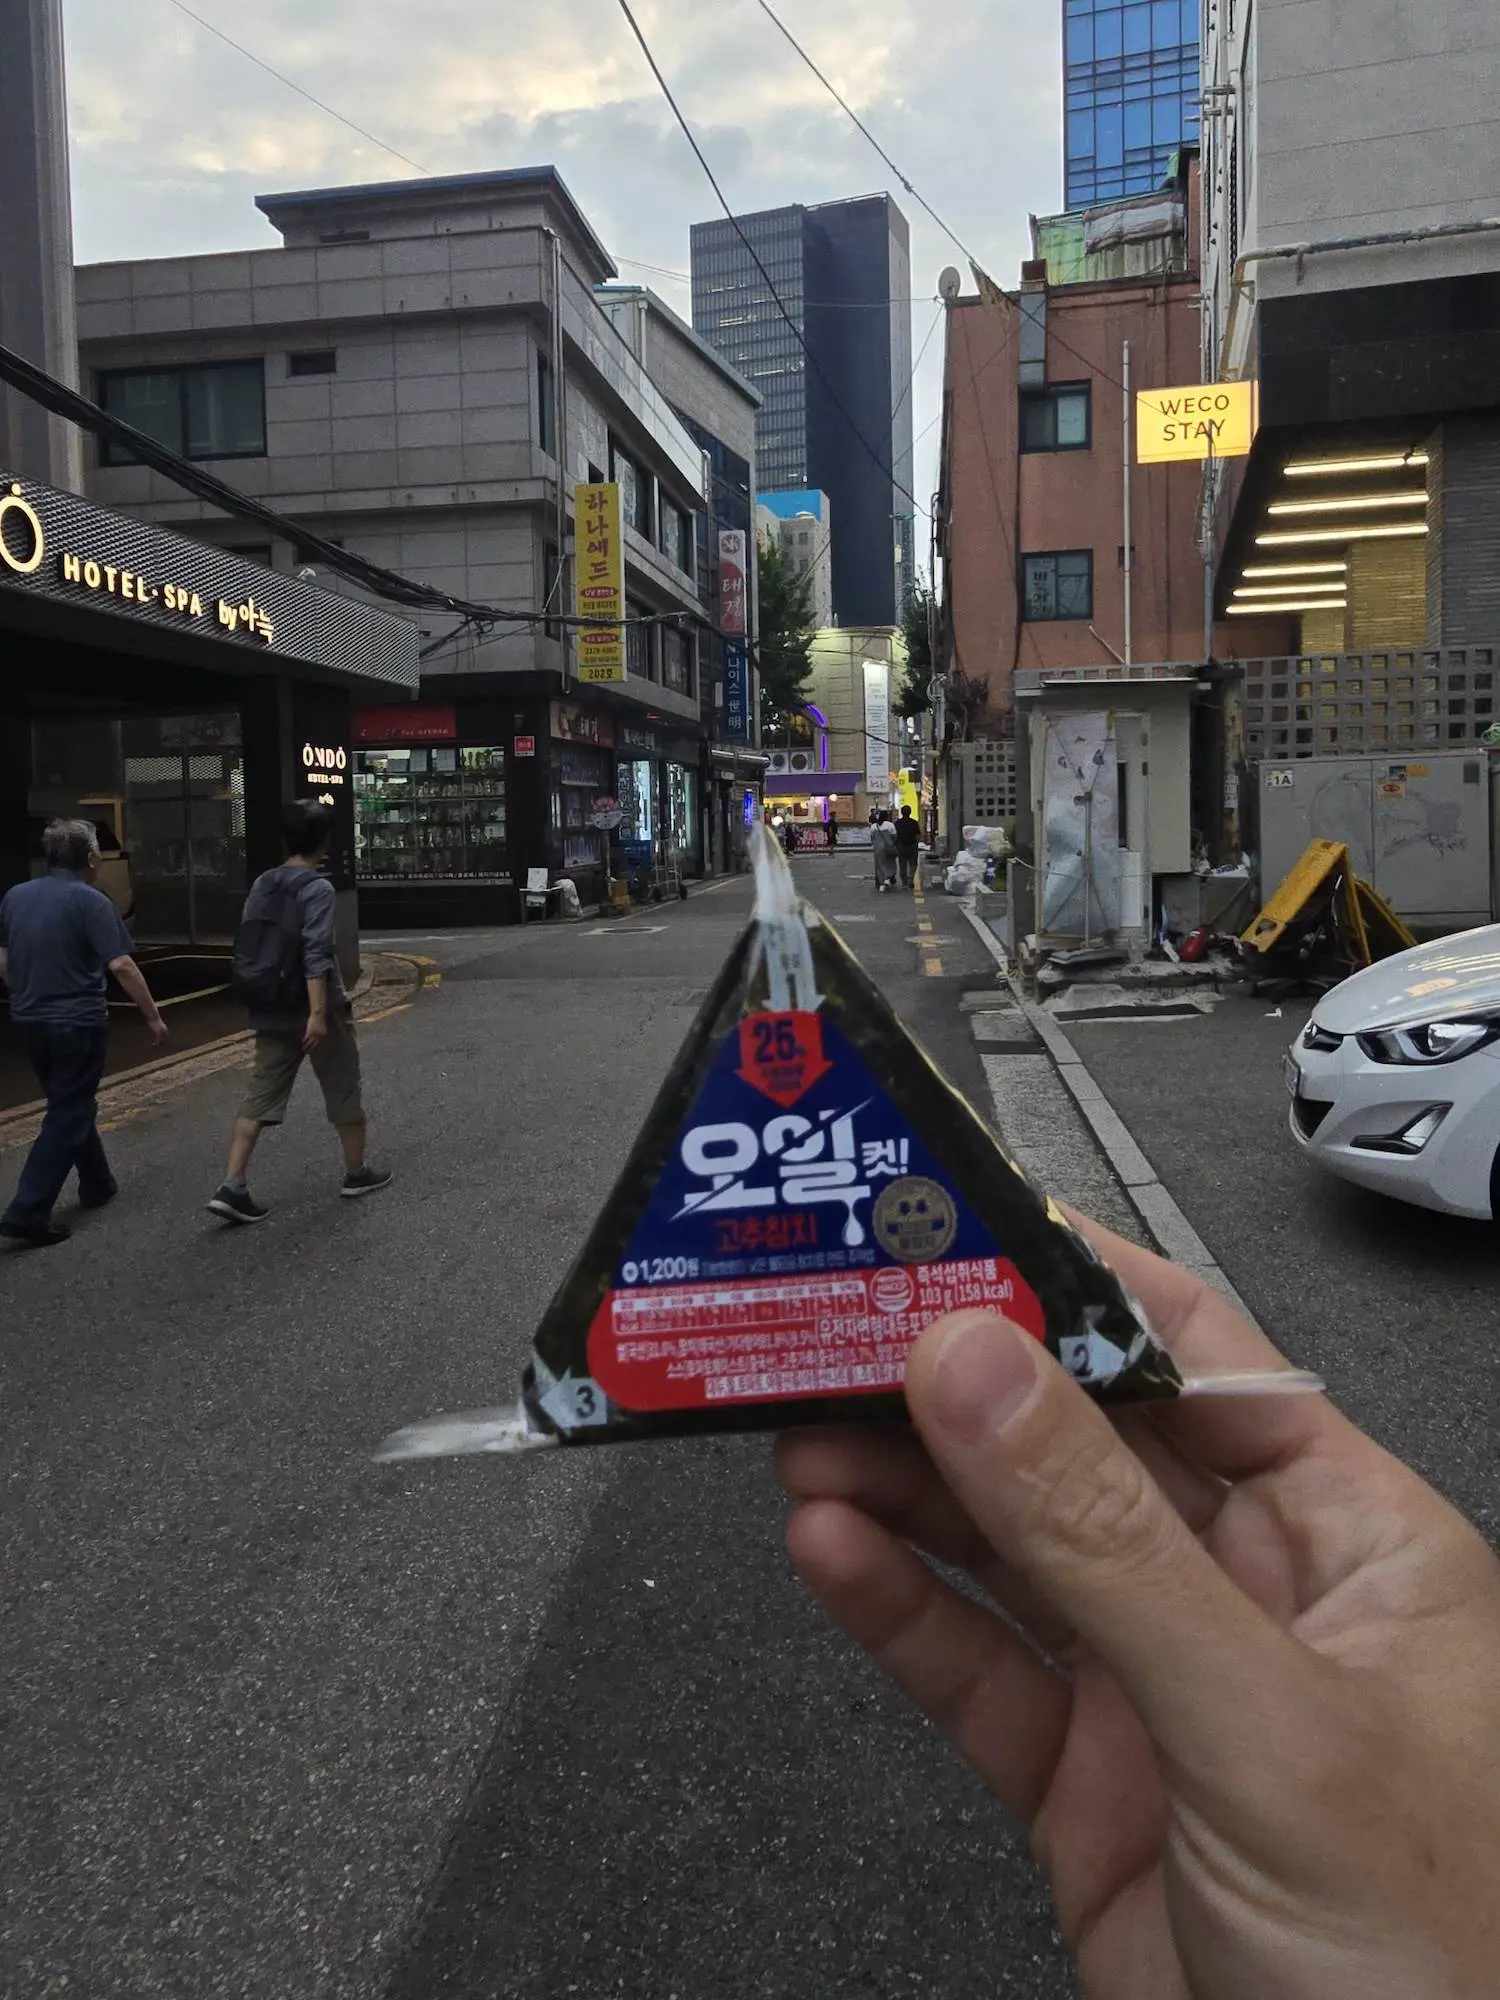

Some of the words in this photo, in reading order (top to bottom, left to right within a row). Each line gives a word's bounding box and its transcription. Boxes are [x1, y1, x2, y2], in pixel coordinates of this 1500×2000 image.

[1160, 394, 1230, 416] WECO
[1162, 418, 1226, 442] STAY
[714, 1212, 819, 1254] 고추참치
[917, 1258, 997, 1286] 즉석섭취식품
[919, 1288, 941, 1306] 103
[954, 1283, 982, 1306] (158
[983, 1279, 1014, 1302] kcal)
[1073, 1343, 1093, 1377] 2
[576, 1385, 596, 1419] 3
